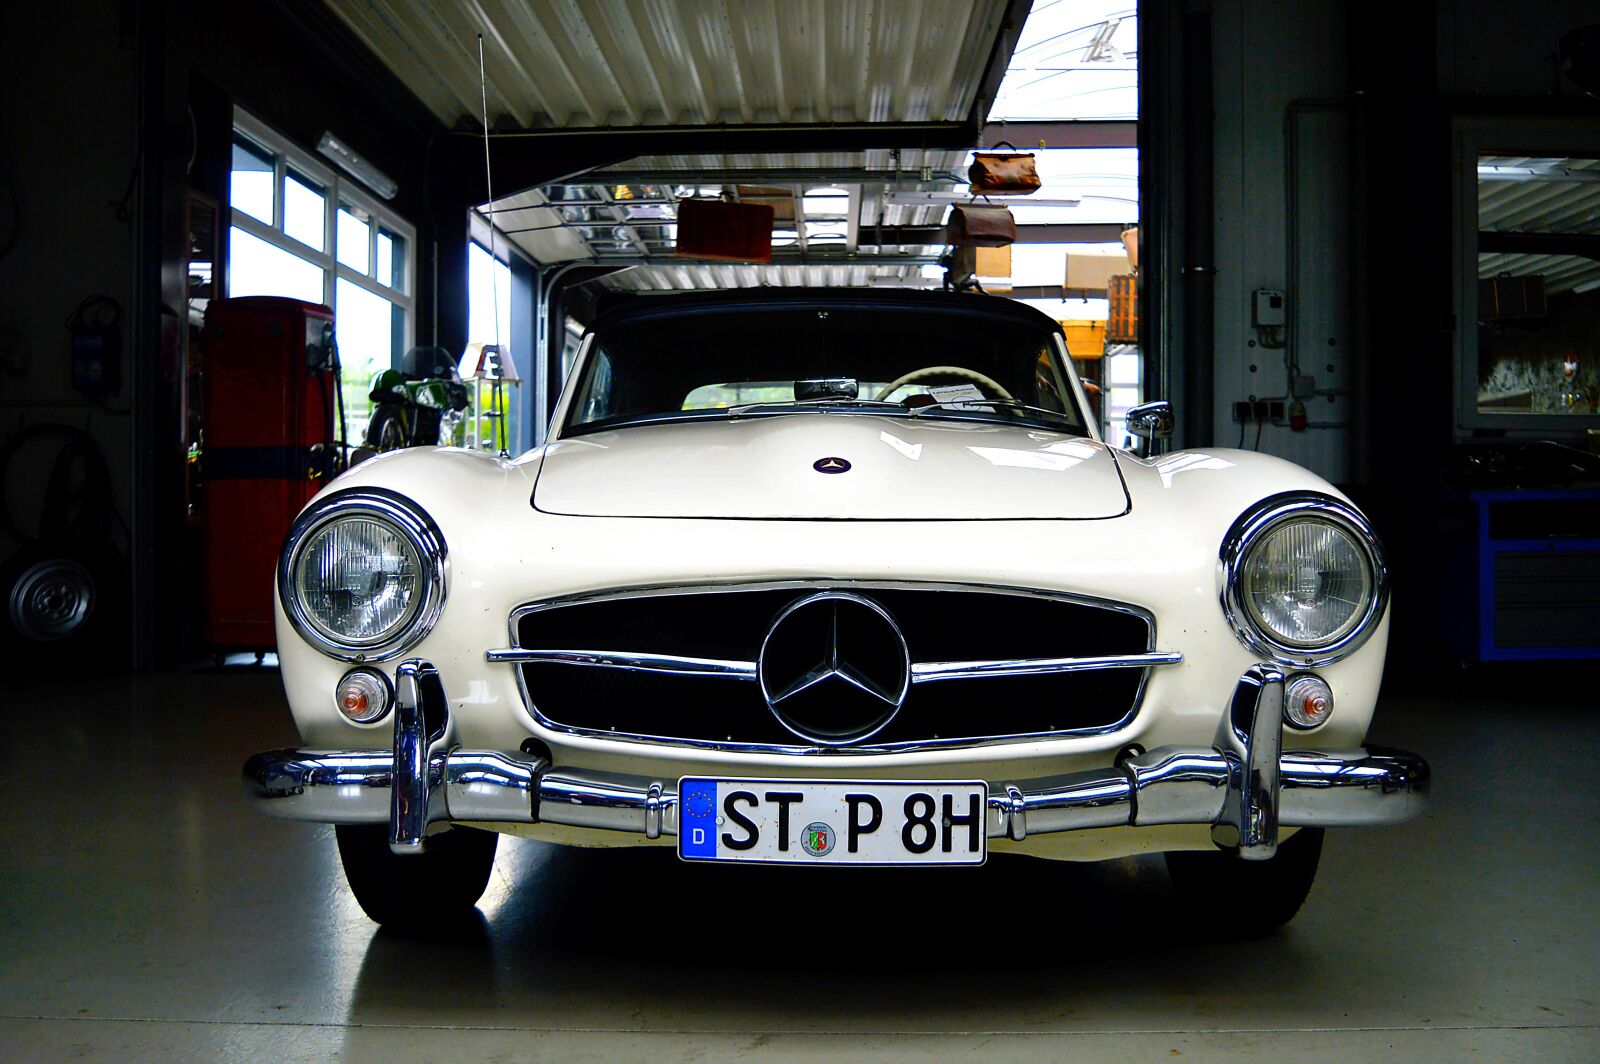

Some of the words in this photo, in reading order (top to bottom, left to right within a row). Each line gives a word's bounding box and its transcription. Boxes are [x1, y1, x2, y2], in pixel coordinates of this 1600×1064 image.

[692, 828, 705, 844] D
[721, 790, 804, 852] ST
[845, 793, 883, 853] P
[901, 792, 981, 854] 8H
